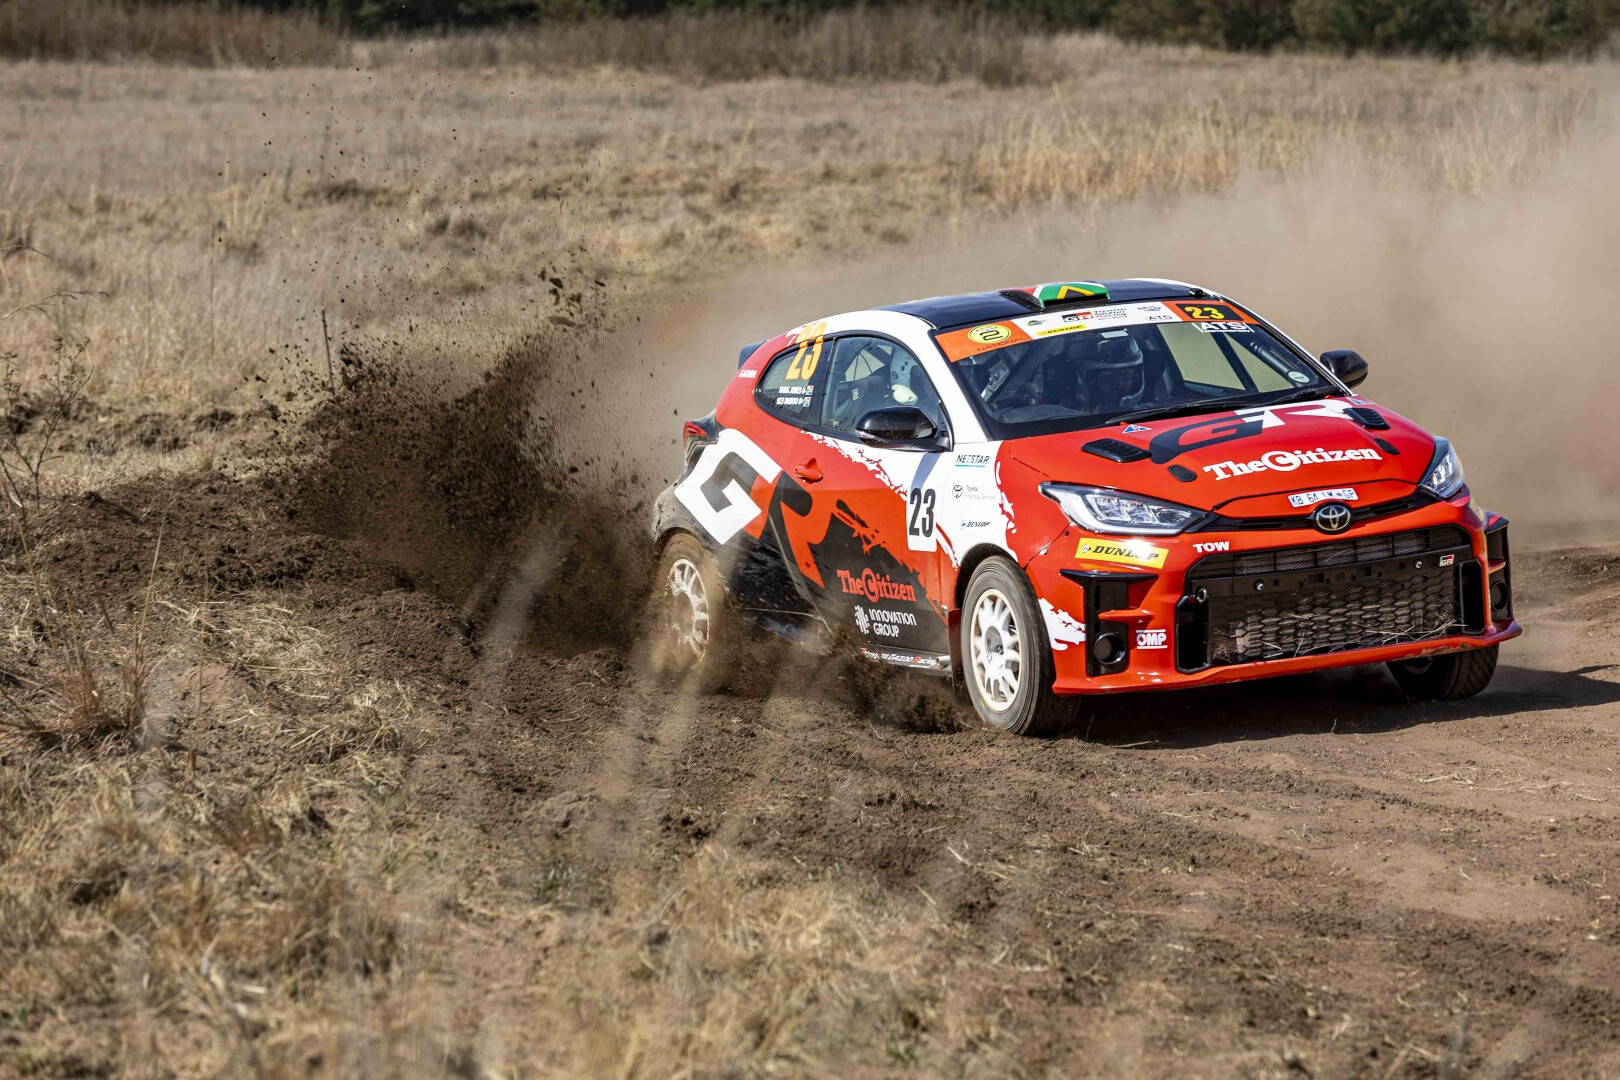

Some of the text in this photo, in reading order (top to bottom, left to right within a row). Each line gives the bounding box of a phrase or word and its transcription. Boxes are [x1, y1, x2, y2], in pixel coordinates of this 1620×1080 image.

[1184, 306, 1224, 319] 23
[1046, 324, 1084, 334] DUNLOP
[1201, 322, 1246, 330] ATS
[979, 329, 1003, 341] 2
[785, 321, 827, 380] 23
[976, 337, 1027, 352] NATIONAL
[955, 454, 990, 464] NETSTAR
[1290, 495, 1304, 506] KB
[1342, 489, 1355, 499] GP
[908, 487, 936, 538] 23
[1192, 540, 1230, 553] TOW
[873, 623, 900, 638] GROUP
[1136, 632, 1168, 647] OMP
